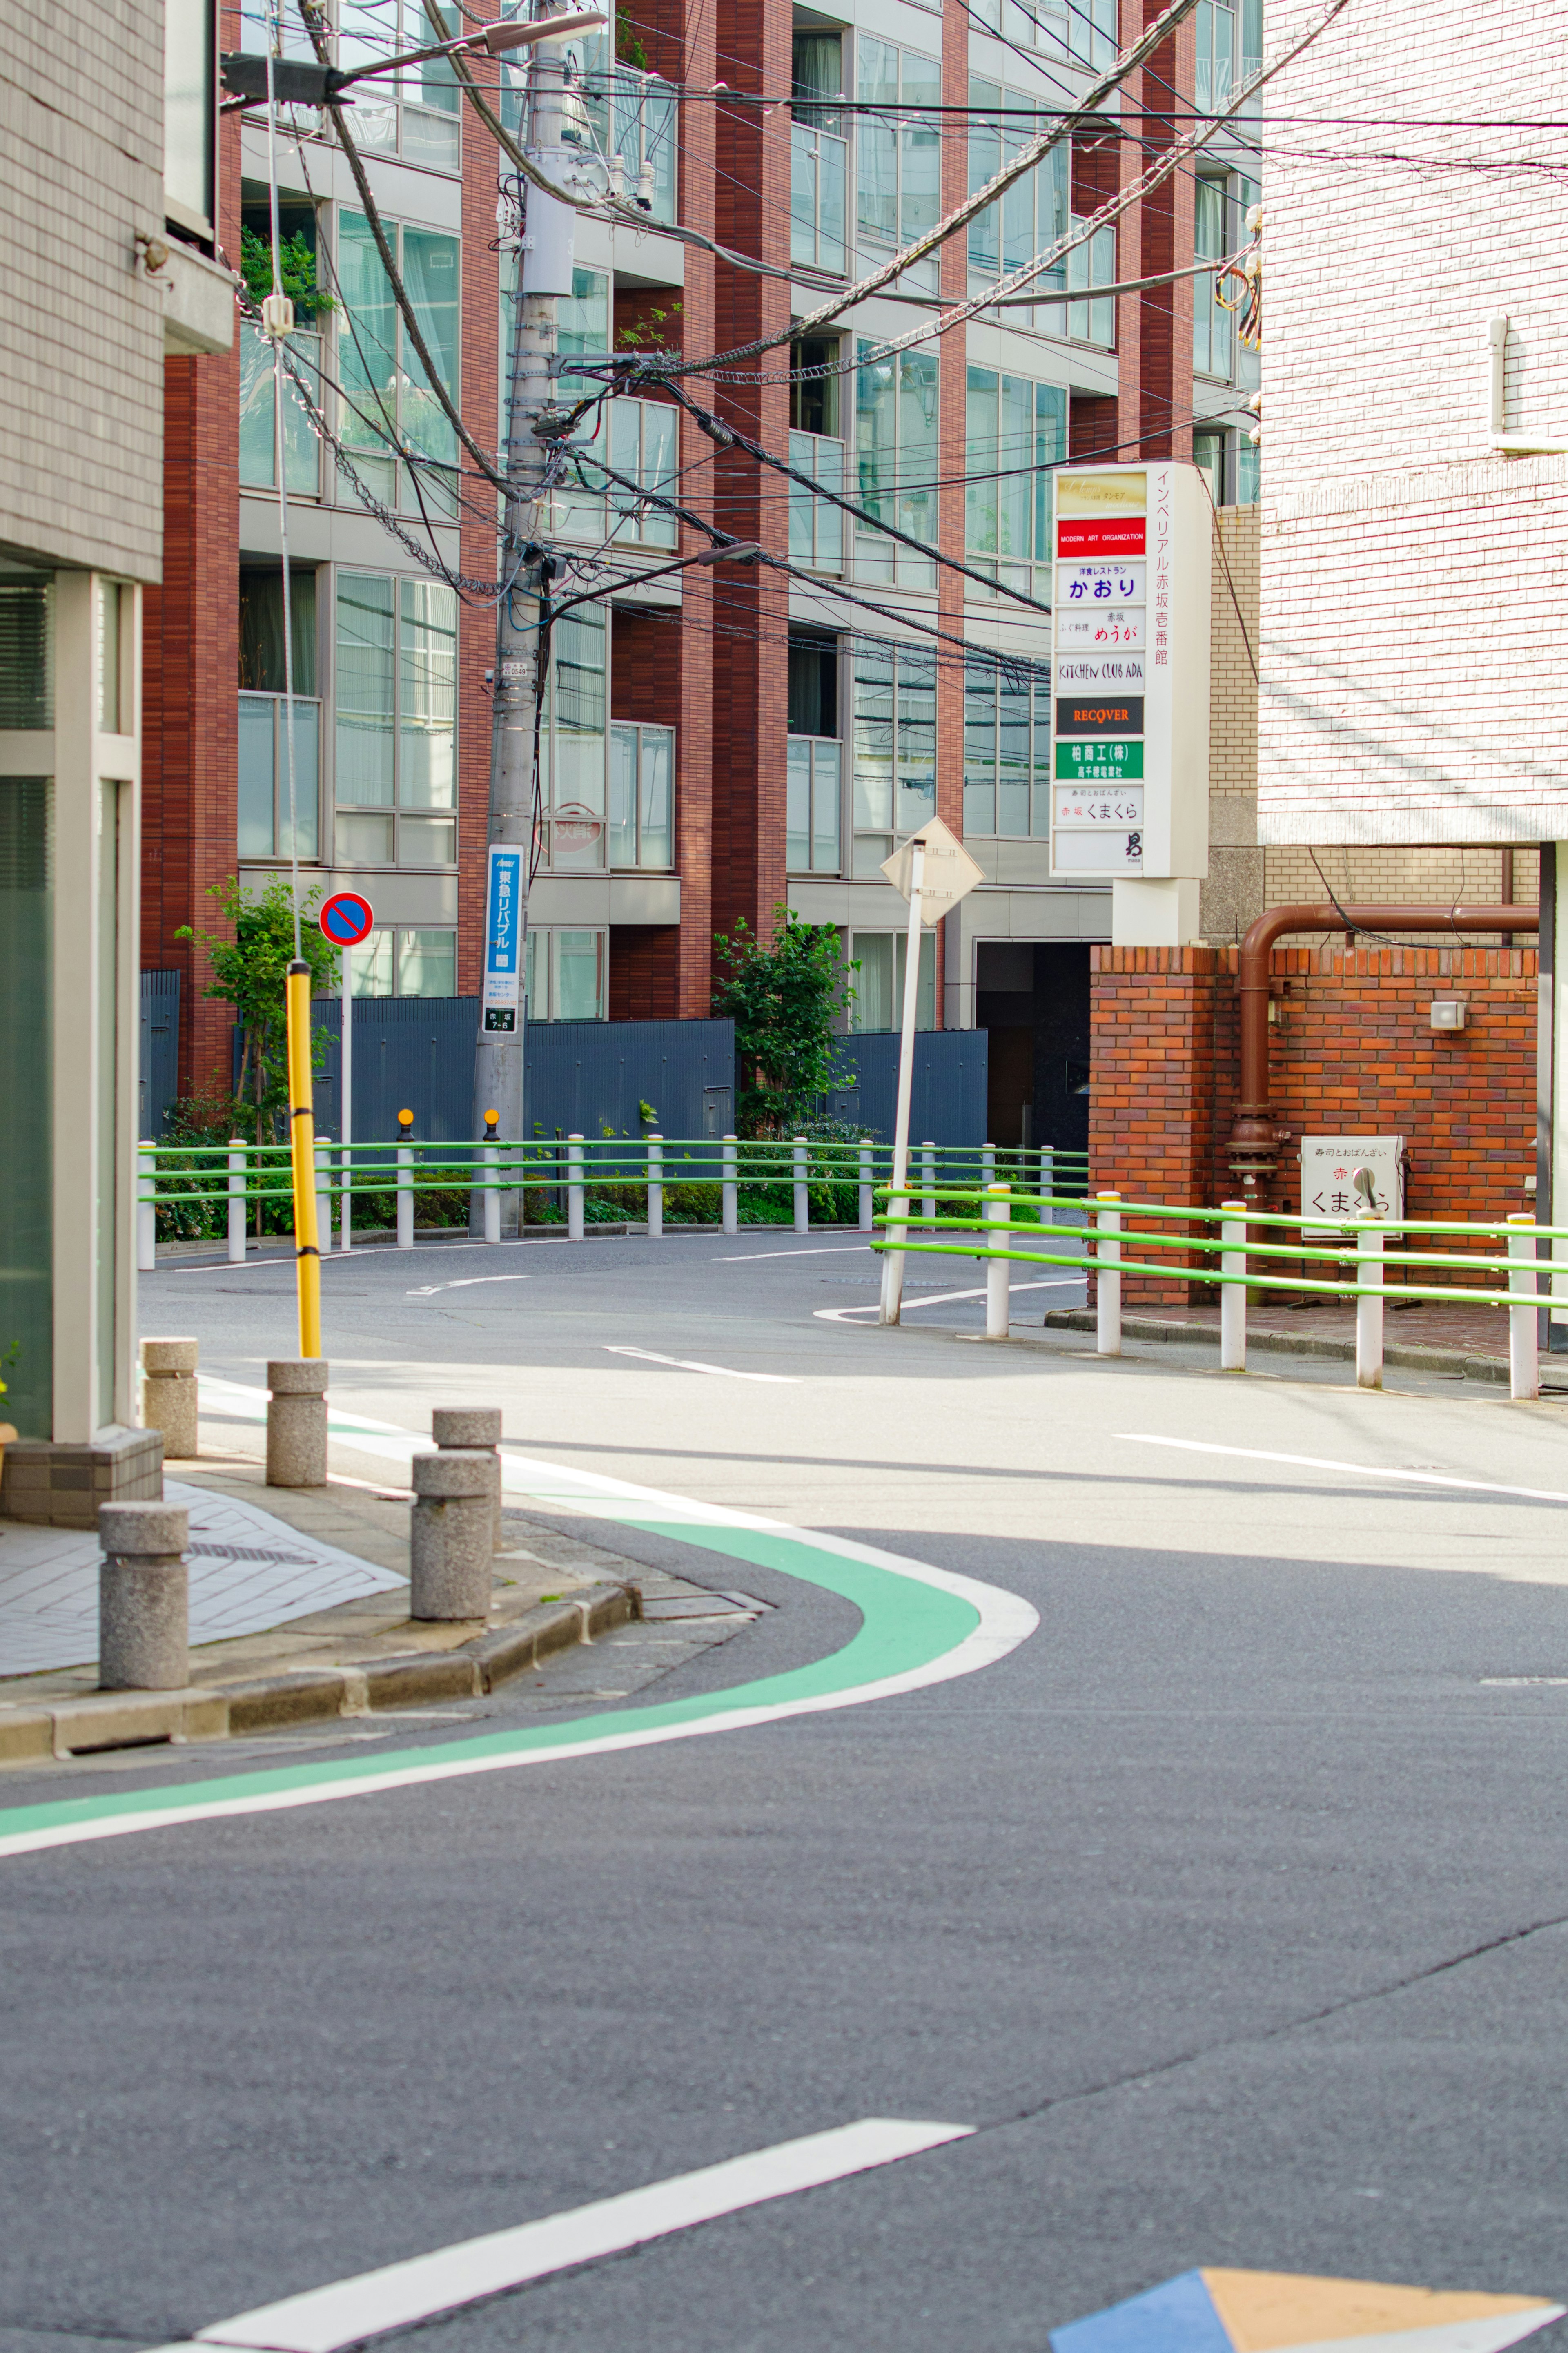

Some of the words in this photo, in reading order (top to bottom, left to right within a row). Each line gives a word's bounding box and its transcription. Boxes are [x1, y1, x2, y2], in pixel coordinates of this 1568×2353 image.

[1103, 492, 1126, 500] タンモア
[1079, 567, 1126, 576] 洋食レストラン
[1155, 471, 1169, 665] インペリアル赤坂壱番館
[1069, 579, 1134, 598] かおり
[1107, 612, 1125, 622] 赤坂
[1059, 623, 1089, 632] ふぐ料理
[1094, 625, 1138, 644] めうが
[1102, 663, 1123, 679] CLUB
[1125, 662, 1143, 678] ADA
[1074, 709, 1129, 724] RECOVER
[1062, 807, 1082, 816] 赤坂
[1088, 803, 1137, 819] くまくら
[496, 870, 511, 949] 東急リバブル
[1315, 1149, 1387, 1157] 寿司とおばんざい
[1333, 1167, 1358, 1180] 赤
